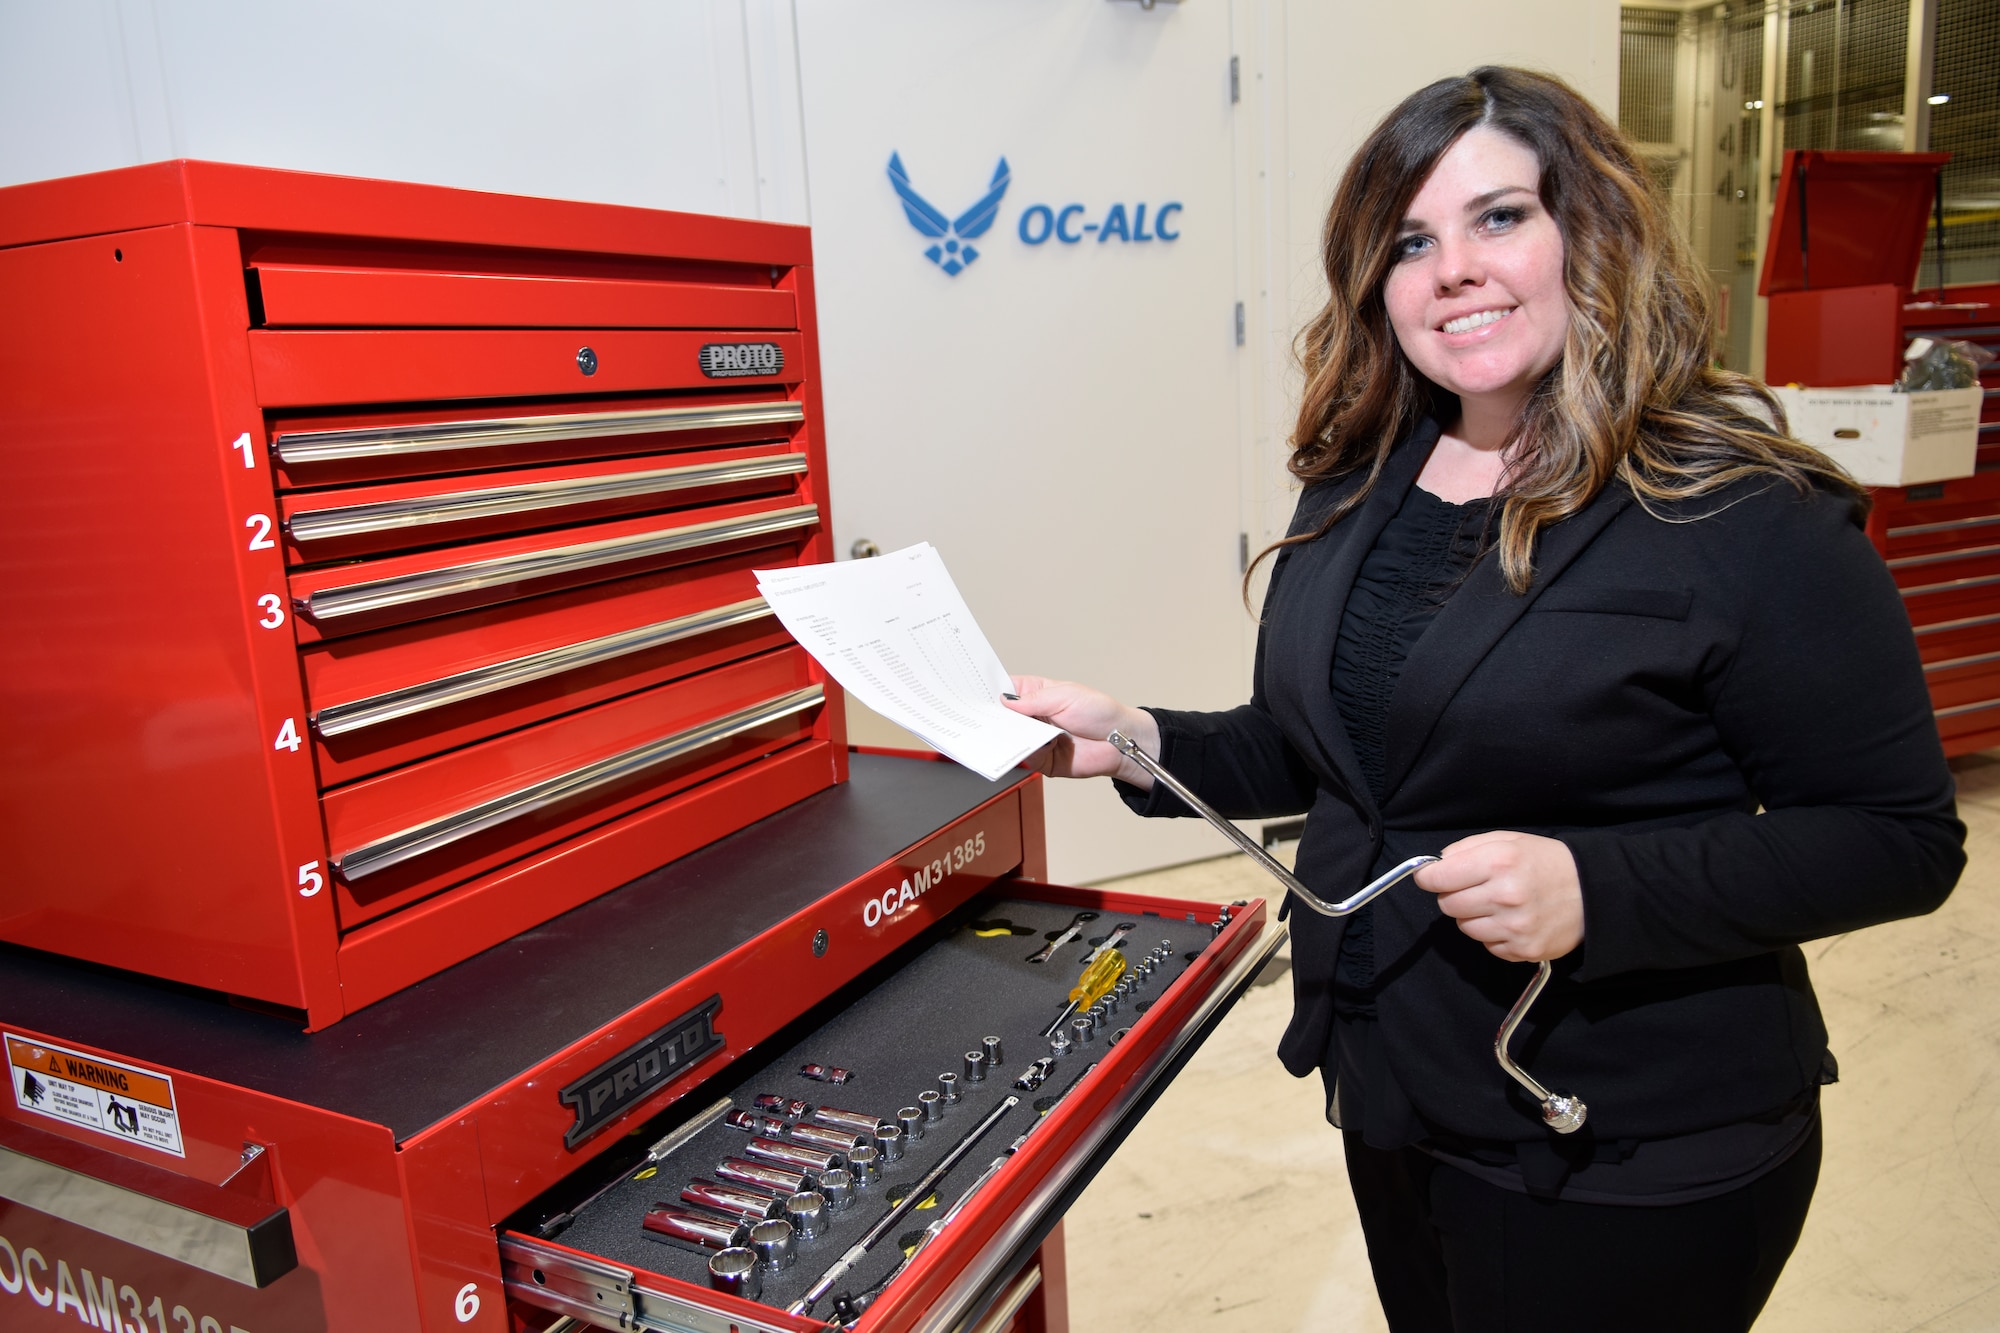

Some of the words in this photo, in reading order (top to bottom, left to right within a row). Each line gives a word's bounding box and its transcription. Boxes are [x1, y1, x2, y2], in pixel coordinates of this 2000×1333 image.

[1018, 202, 1182, 244] OC-ALC
[709, 344, 776, 369] PROTO
[712, 369, 758, 377] PROFESSIONAL
[232, 432, 255, 469] 1
[245, 514, 275, 551] 2
[257, 593, 285, 629] 3
[274, 717, 302, 752] 4
[298, 860, 323, 897] 5
[863, 831, 985, 927] OCAM31385
[58, 1082, 67, 1090] MAY
[66, 1059, 129, 1091] WARNING
[588, 1020, 704, 1117] PROTO
[138, 1103, 157, 1115] SERIOUS
[158, 1109, 174, 1119] INJURY
[140, 1111, 150, 1120] MAY
[151, 1115, 167, 1124] OCCUR
[455, 1282, 480, 1322] 6
